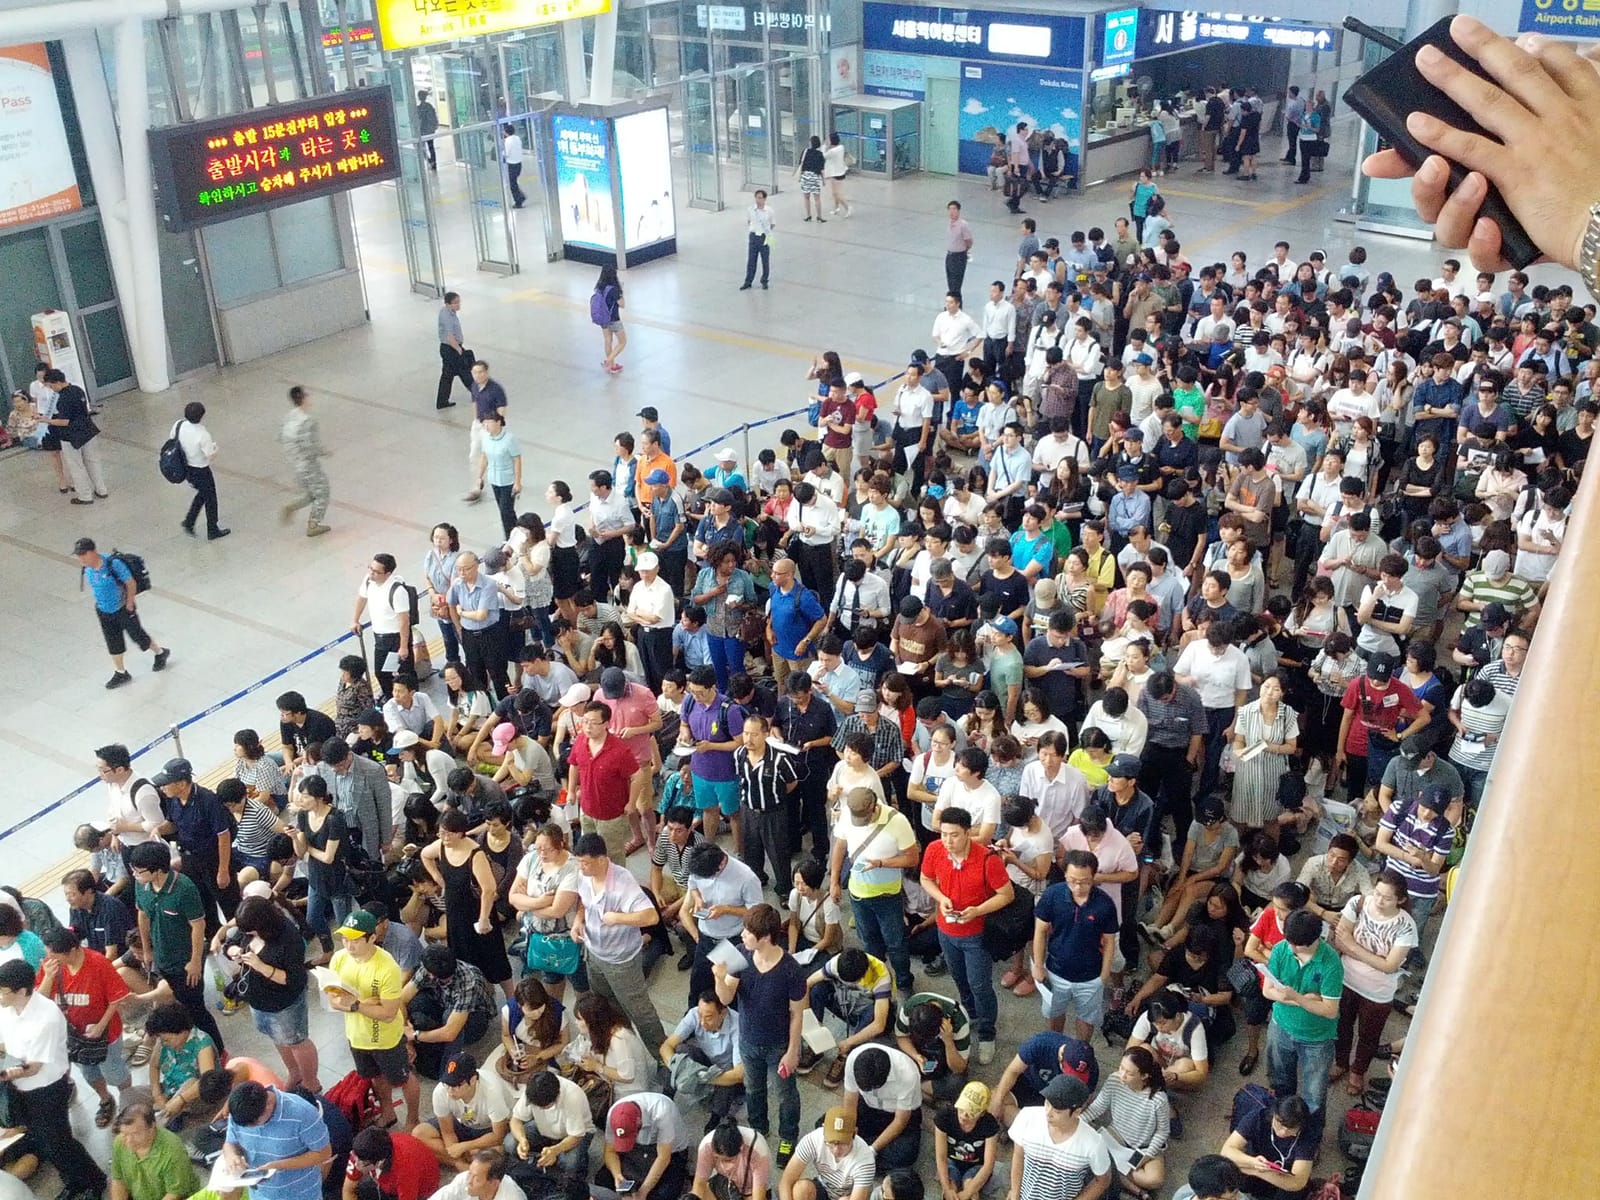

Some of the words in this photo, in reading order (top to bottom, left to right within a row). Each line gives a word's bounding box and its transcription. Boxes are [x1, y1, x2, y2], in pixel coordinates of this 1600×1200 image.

[892, 19, 981, 44] 서울역여행센터
[1535, 13, 1574, 26] Airport
[1, 96, 33, 108] Pass
[232, 128, 258, 147] 출발
[262, 115, 319, 141] 15분전부터
[323, 109, 347, 128] 입장
[207, 146, 292, 181] 출발시각과
[300, 135, 334, 158] 타는
[341, 128, 371, 151] 곳을
[198, 181, 259, 207] 확인하시고
[260, 170, 296, 192] 승차해
[299, 162, 333, 183] 주시기
[336, 151, 384, 173] 바랍니다.
[371, 1018, 380, 1044] Reebo
[615, 1127, 625, 1137] P
